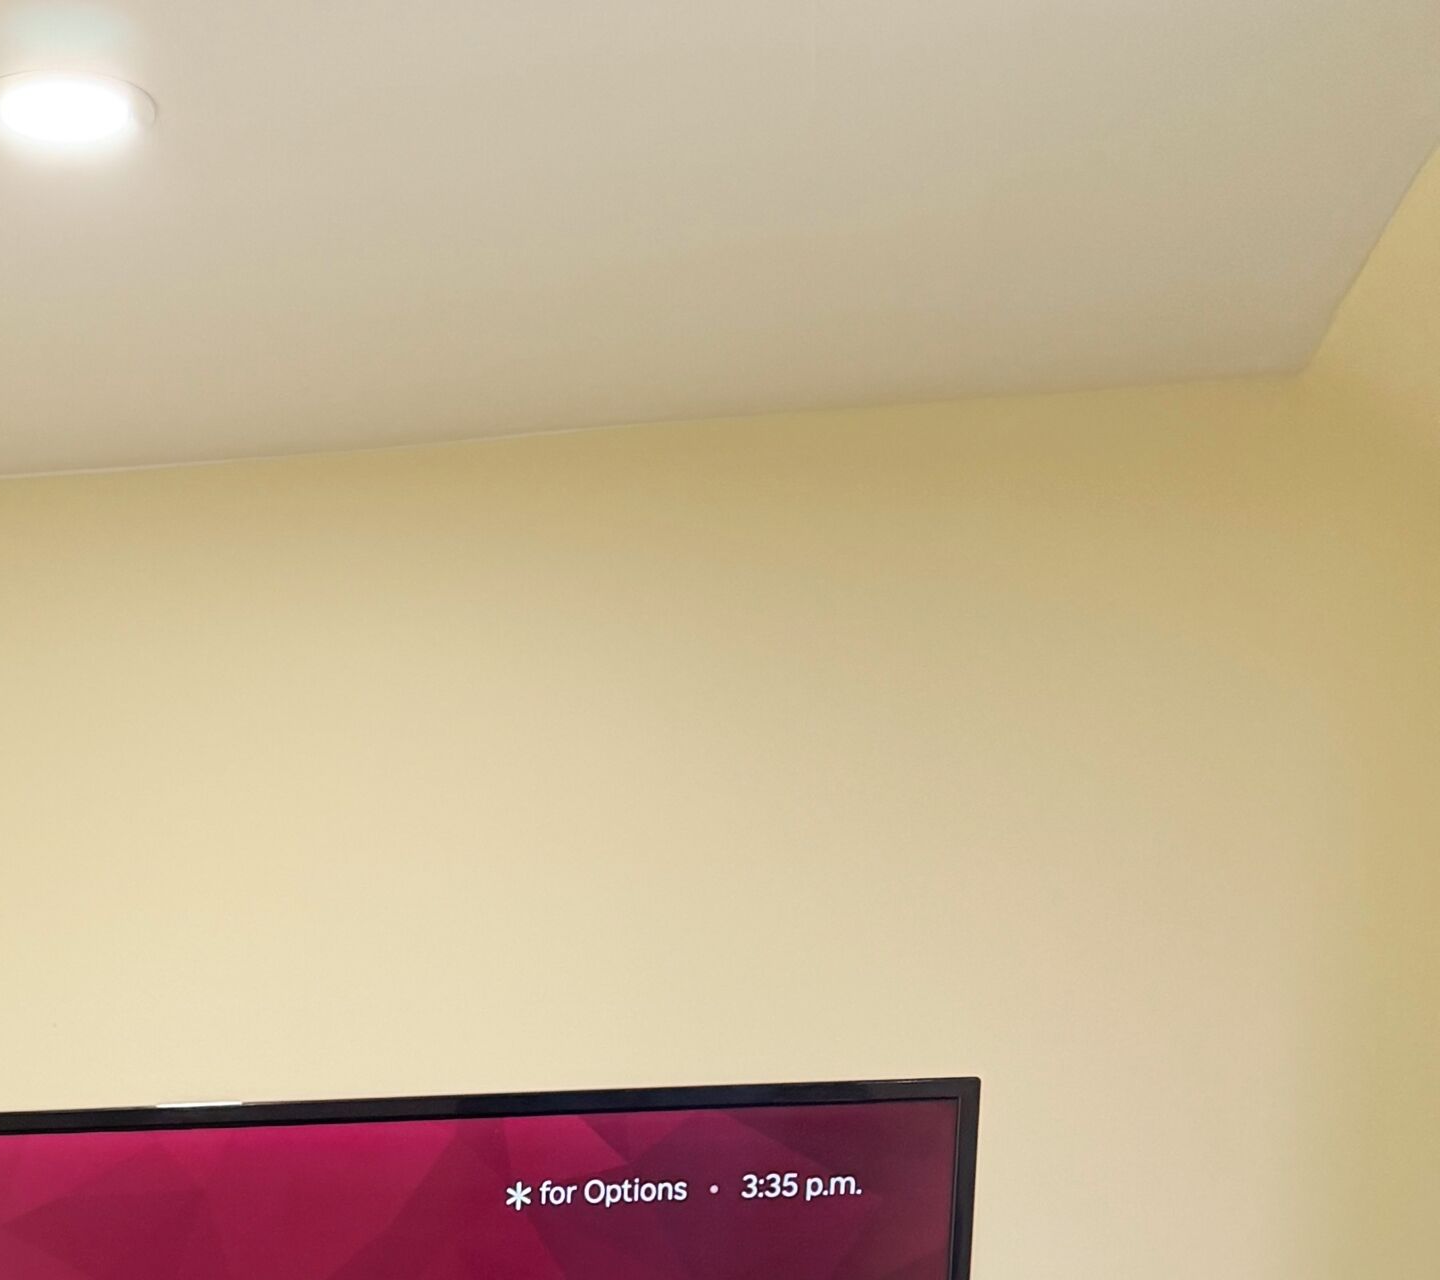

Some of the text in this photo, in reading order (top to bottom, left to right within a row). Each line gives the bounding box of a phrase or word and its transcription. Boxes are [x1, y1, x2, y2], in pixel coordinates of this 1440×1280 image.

[539, 1173, 862, 1210] for Options 3:35 p.m.
